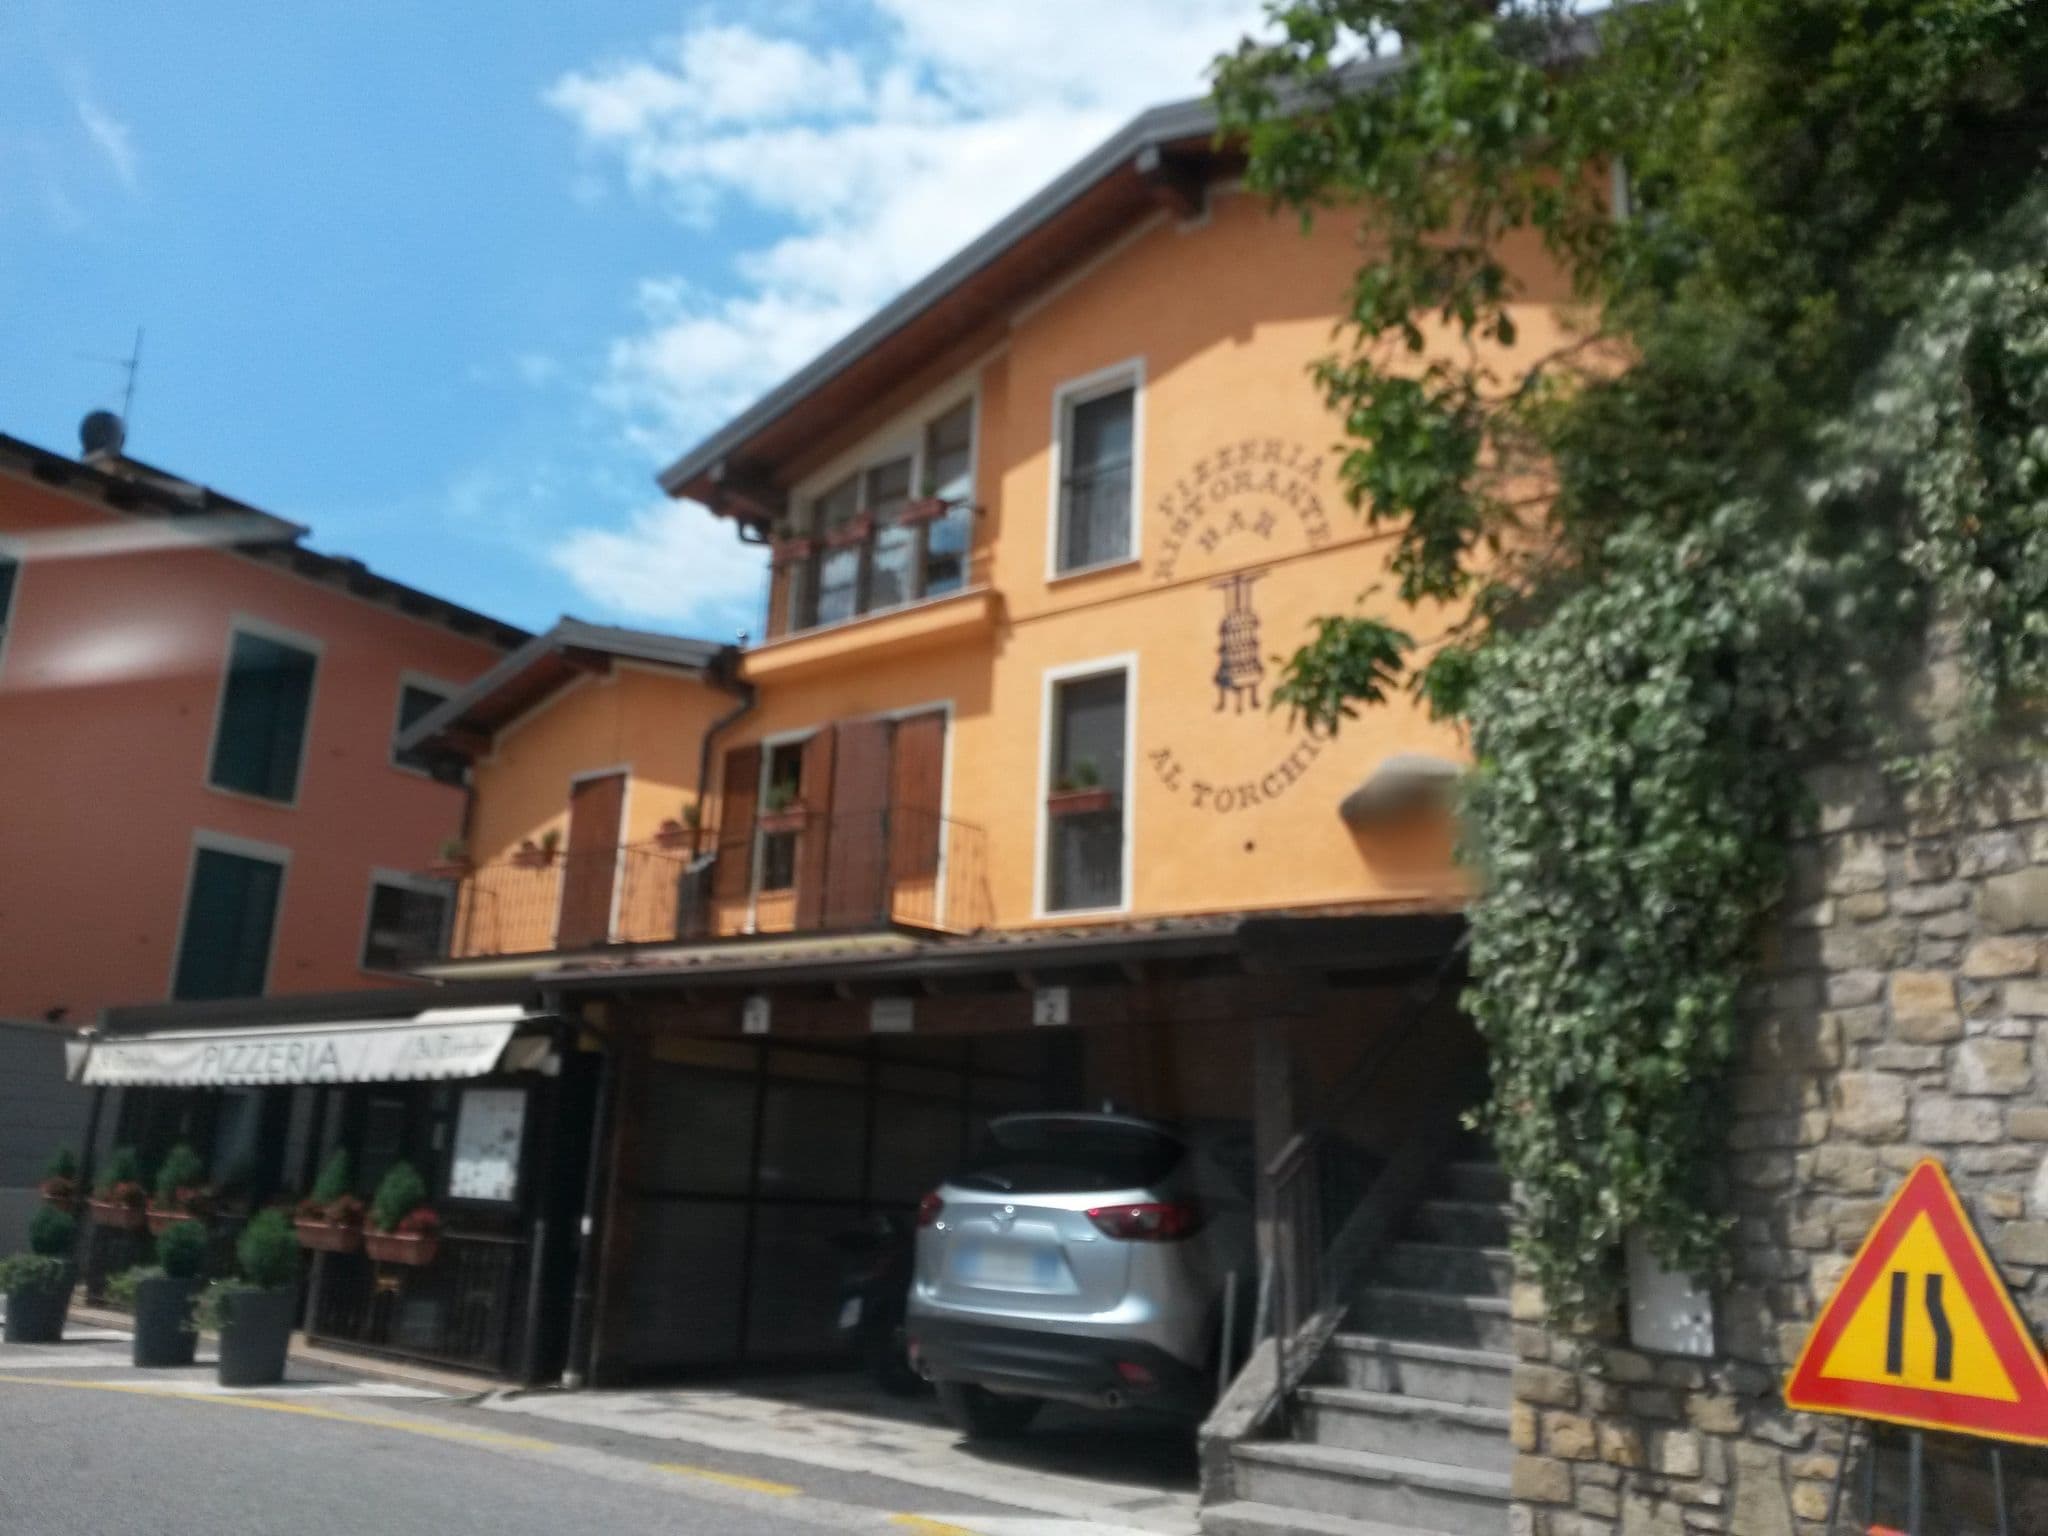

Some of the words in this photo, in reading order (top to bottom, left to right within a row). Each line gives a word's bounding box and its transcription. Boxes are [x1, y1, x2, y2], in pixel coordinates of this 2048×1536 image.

[1158, 439, 1323, 516] PIZZERIA
[1153, 469, 1330, 578] RISTORANTE
[1198, 508, 1276, 553] BAR
[1149, 747, 1182, 791] AL
[201, 1040, 342, 1074] PIZZERIA
